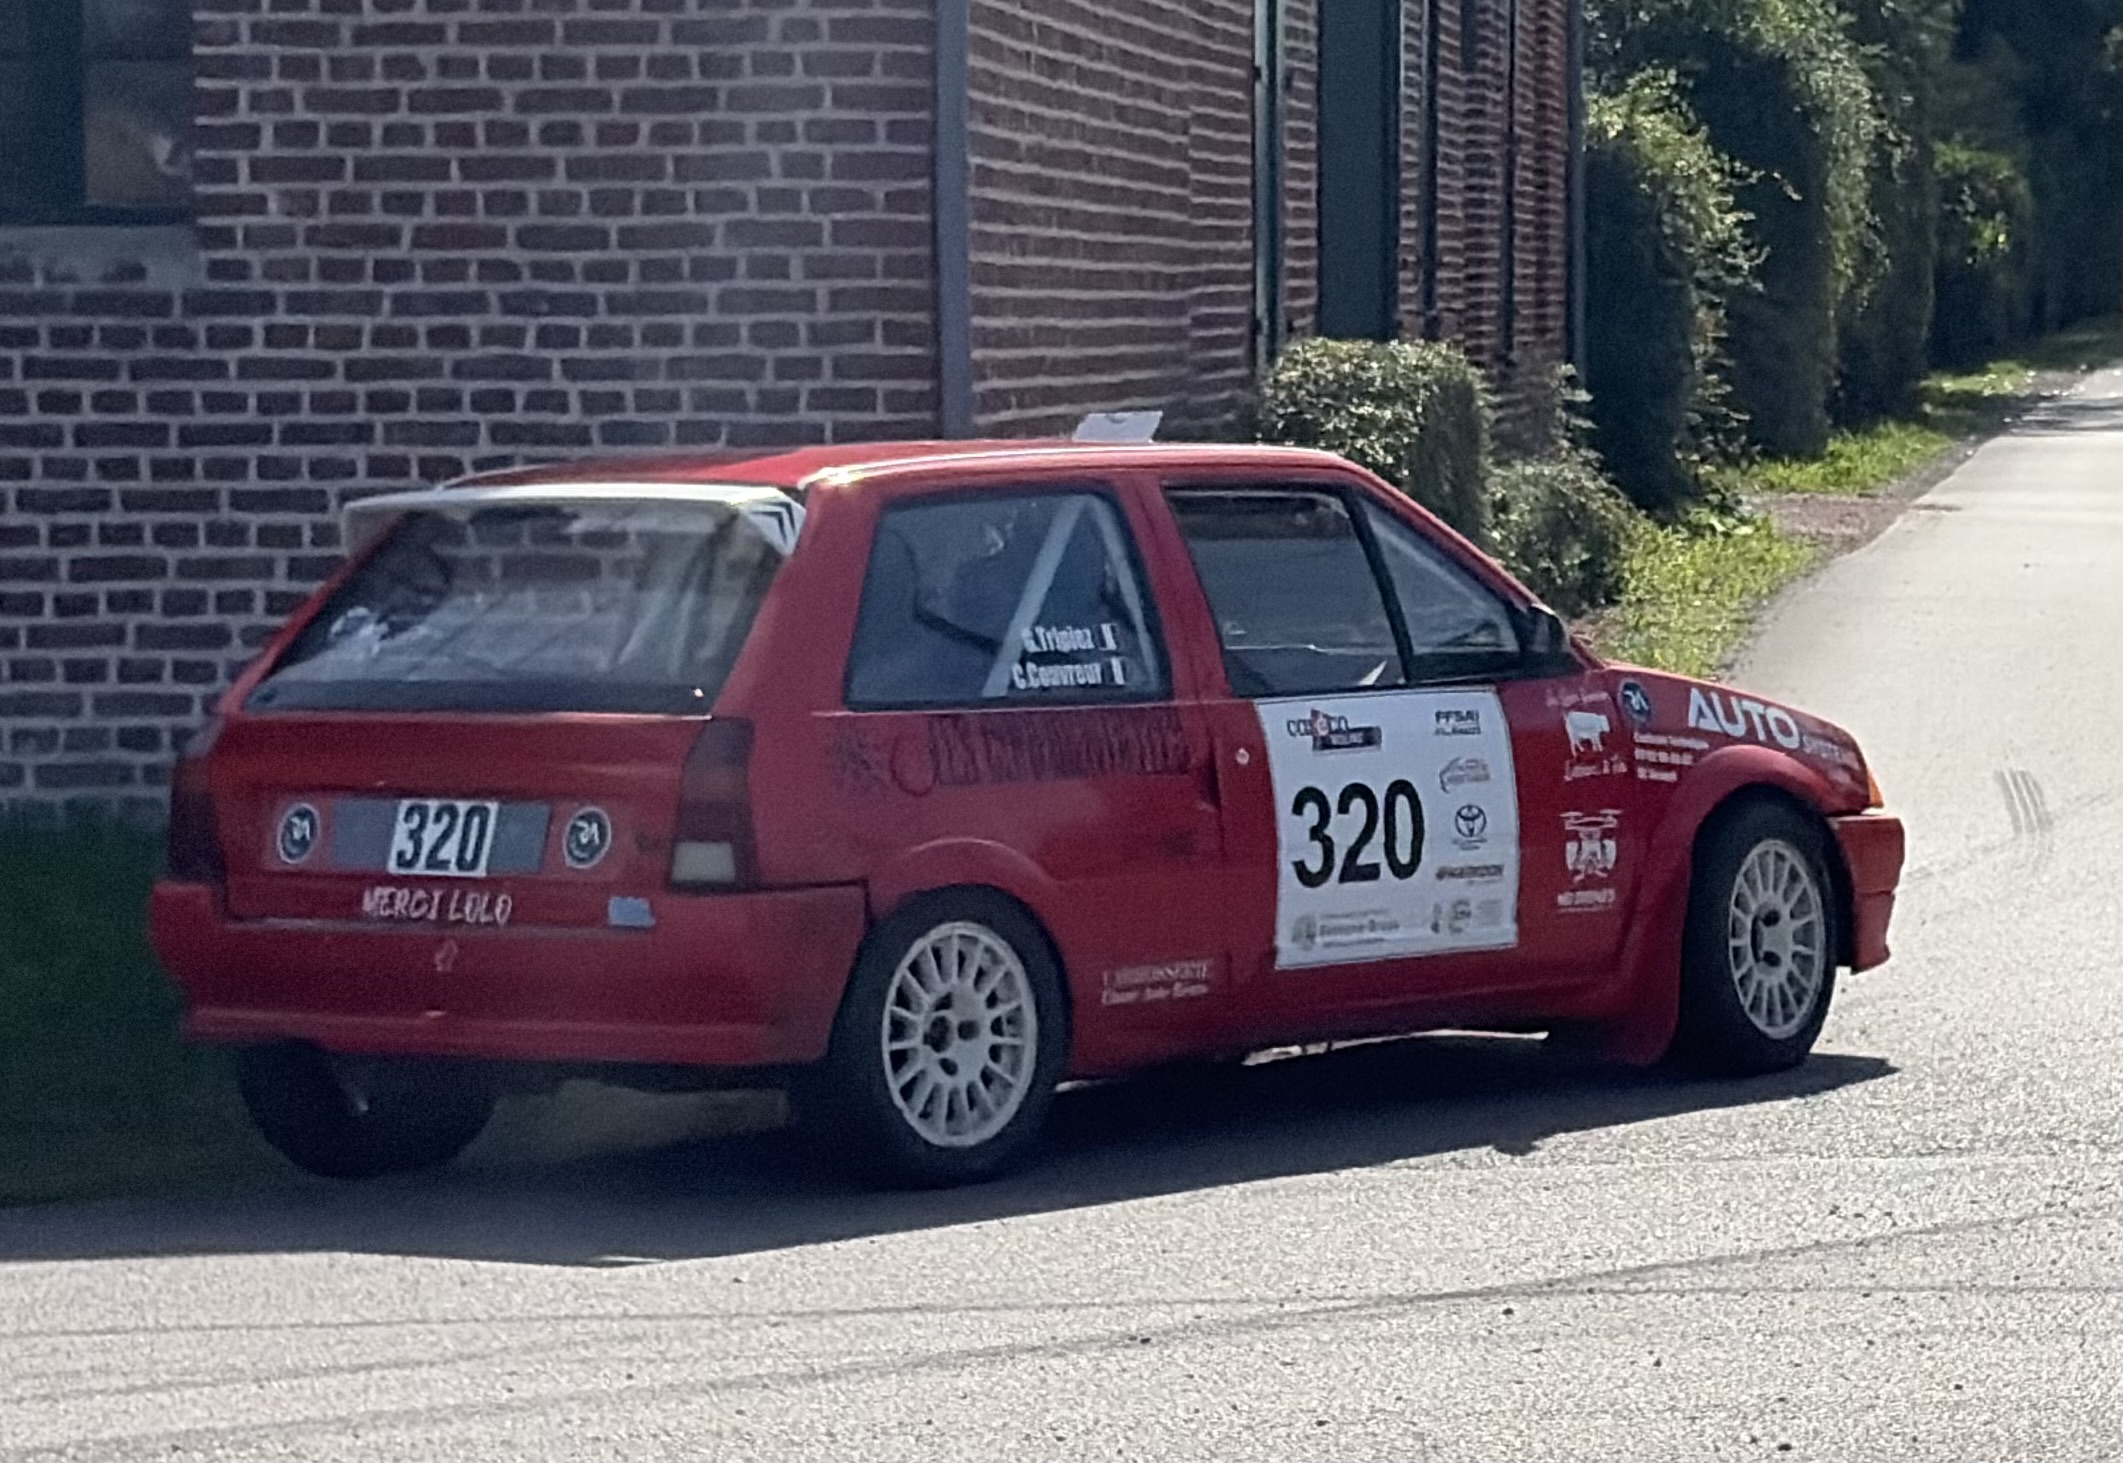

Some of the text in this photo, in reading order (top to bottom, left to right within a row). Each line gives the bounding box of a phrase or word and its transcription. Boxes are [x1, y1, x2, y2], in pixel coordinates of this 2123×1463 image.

[1688, 687, 1800, 749] AUTO
[396, 803, 491, 872] 320
[1291, 778, 1425, 888] 320
[448, 888, 513, 926] LOLO
